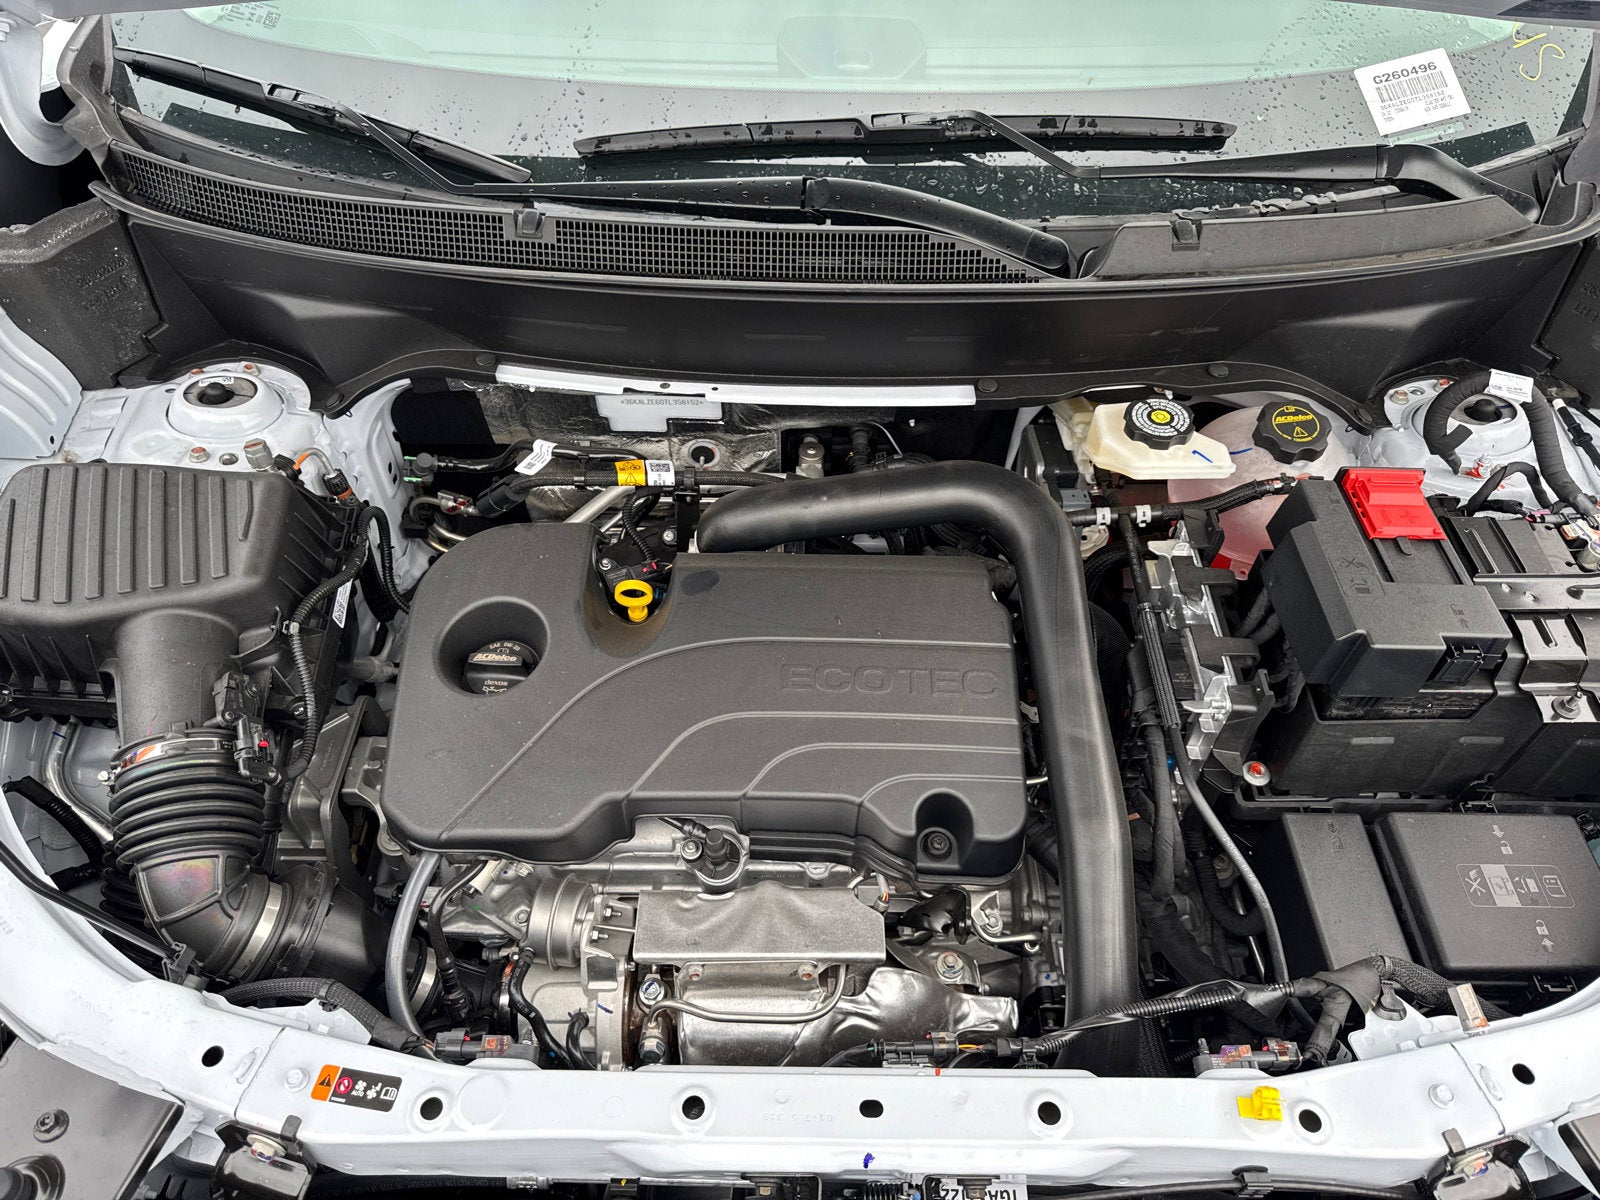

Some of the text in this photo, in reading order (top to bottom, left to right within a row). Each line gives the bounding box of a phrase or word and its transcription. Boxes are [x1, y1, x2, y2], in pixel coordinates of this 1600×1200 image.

[1373, 62, 1437, 84] G260496
[474, 653, 517, 661] ACDelco
[780, 663, 998, 699] ECOTEC
